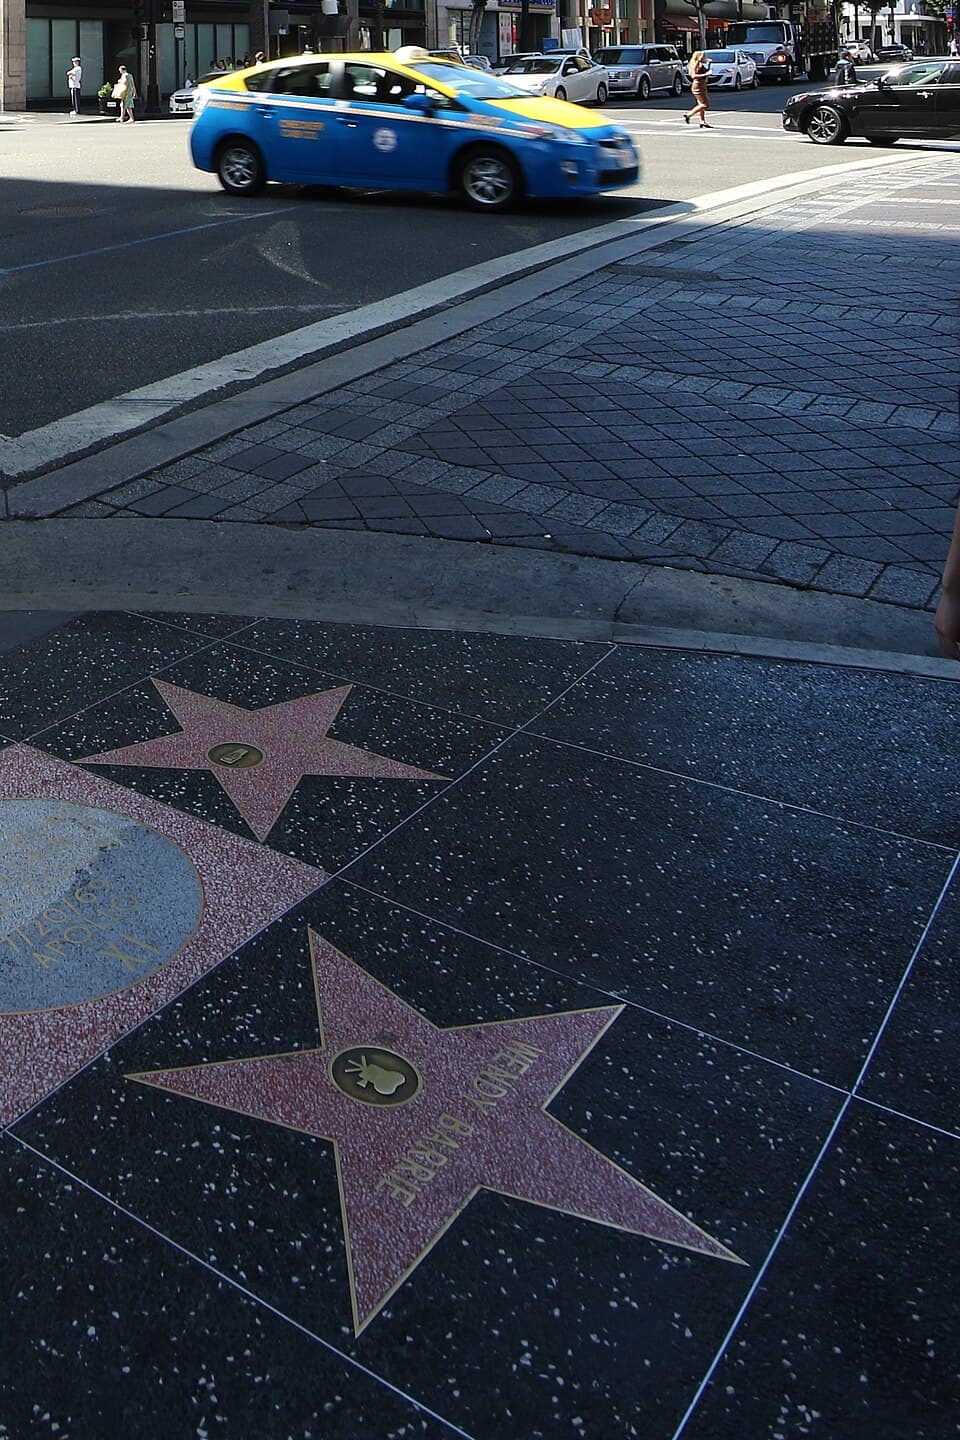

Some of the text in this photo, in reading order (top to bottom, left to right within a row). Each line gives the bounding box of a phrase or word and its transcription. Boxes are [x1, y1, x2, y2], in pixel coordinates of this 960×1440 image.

[24, 888, 148, 970] APOLLO
[95, 929, 163, 972] XI
[370, 1035, 545, 1209] WENDY BARRIE
